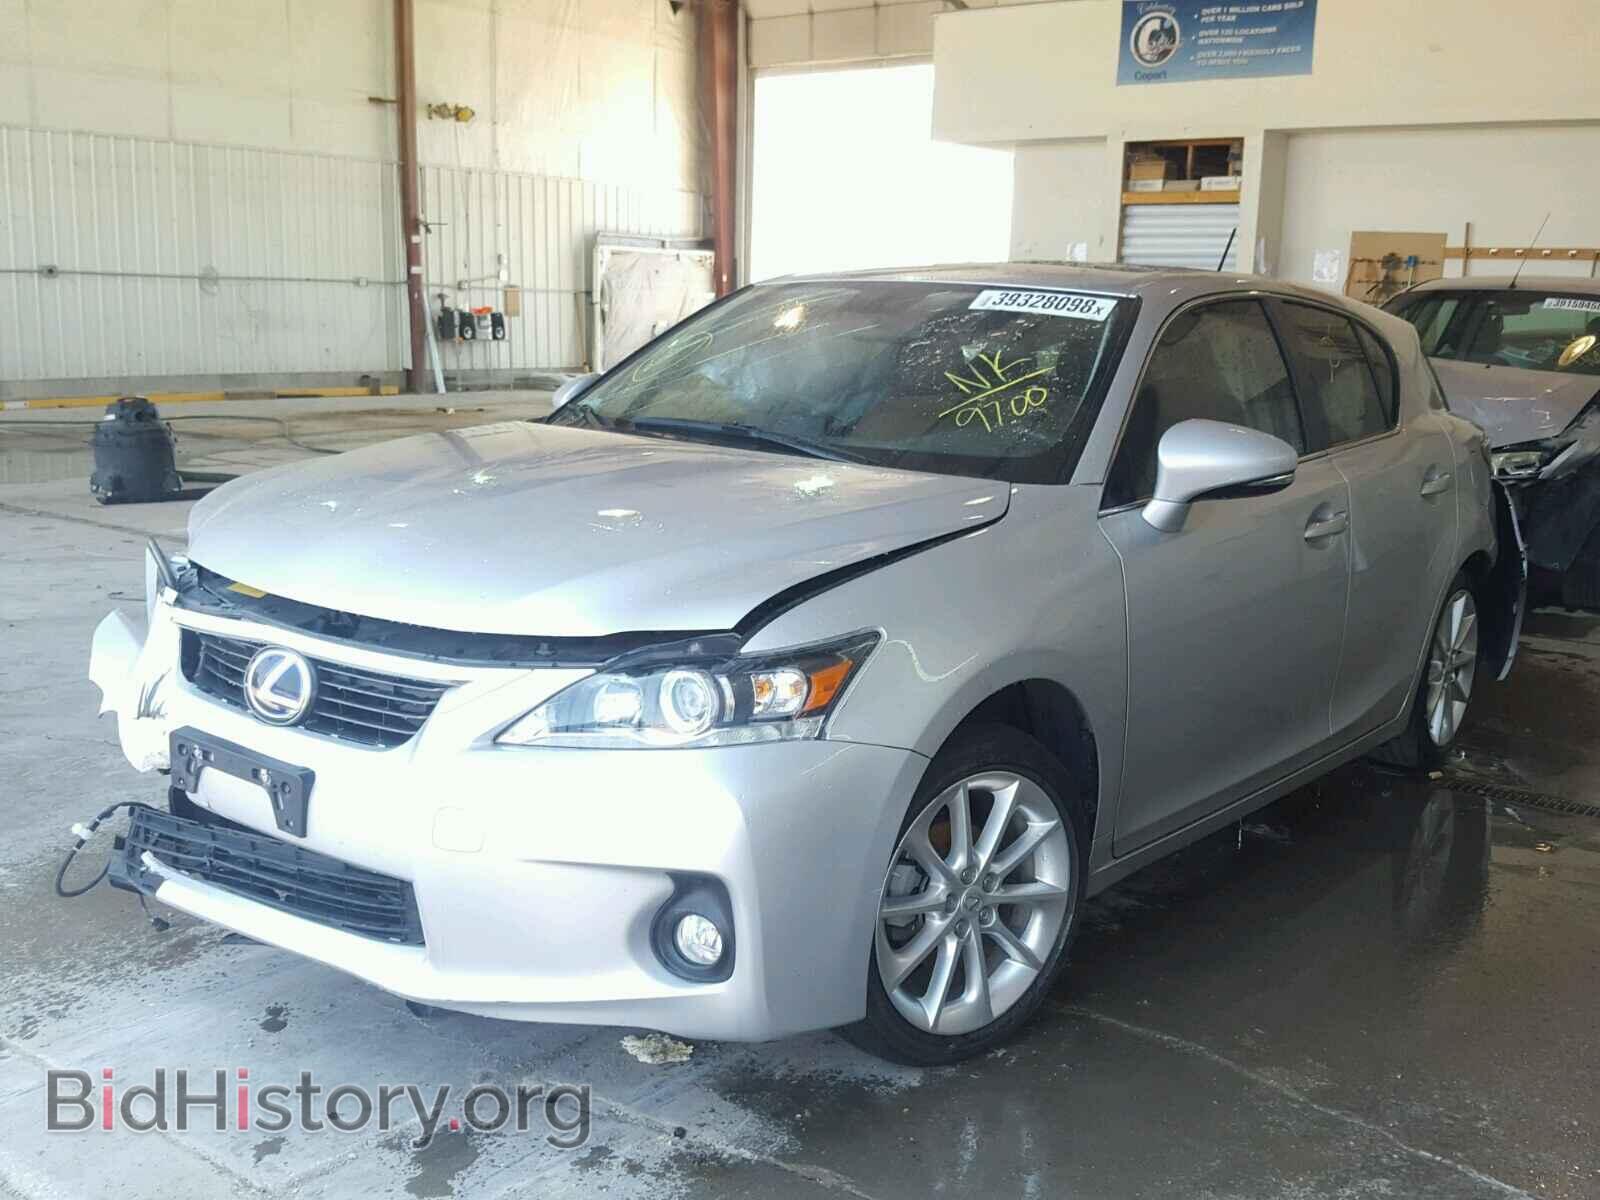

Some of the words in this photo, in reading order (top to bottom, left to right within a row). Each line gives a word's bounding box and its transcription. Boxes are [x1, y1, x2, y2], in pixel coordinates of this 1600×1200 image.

[1261, 4, 1282, 12] CARS
[1135, 69, 1168, 81] Copart
[991, 291, 1097, 315] 39328098
